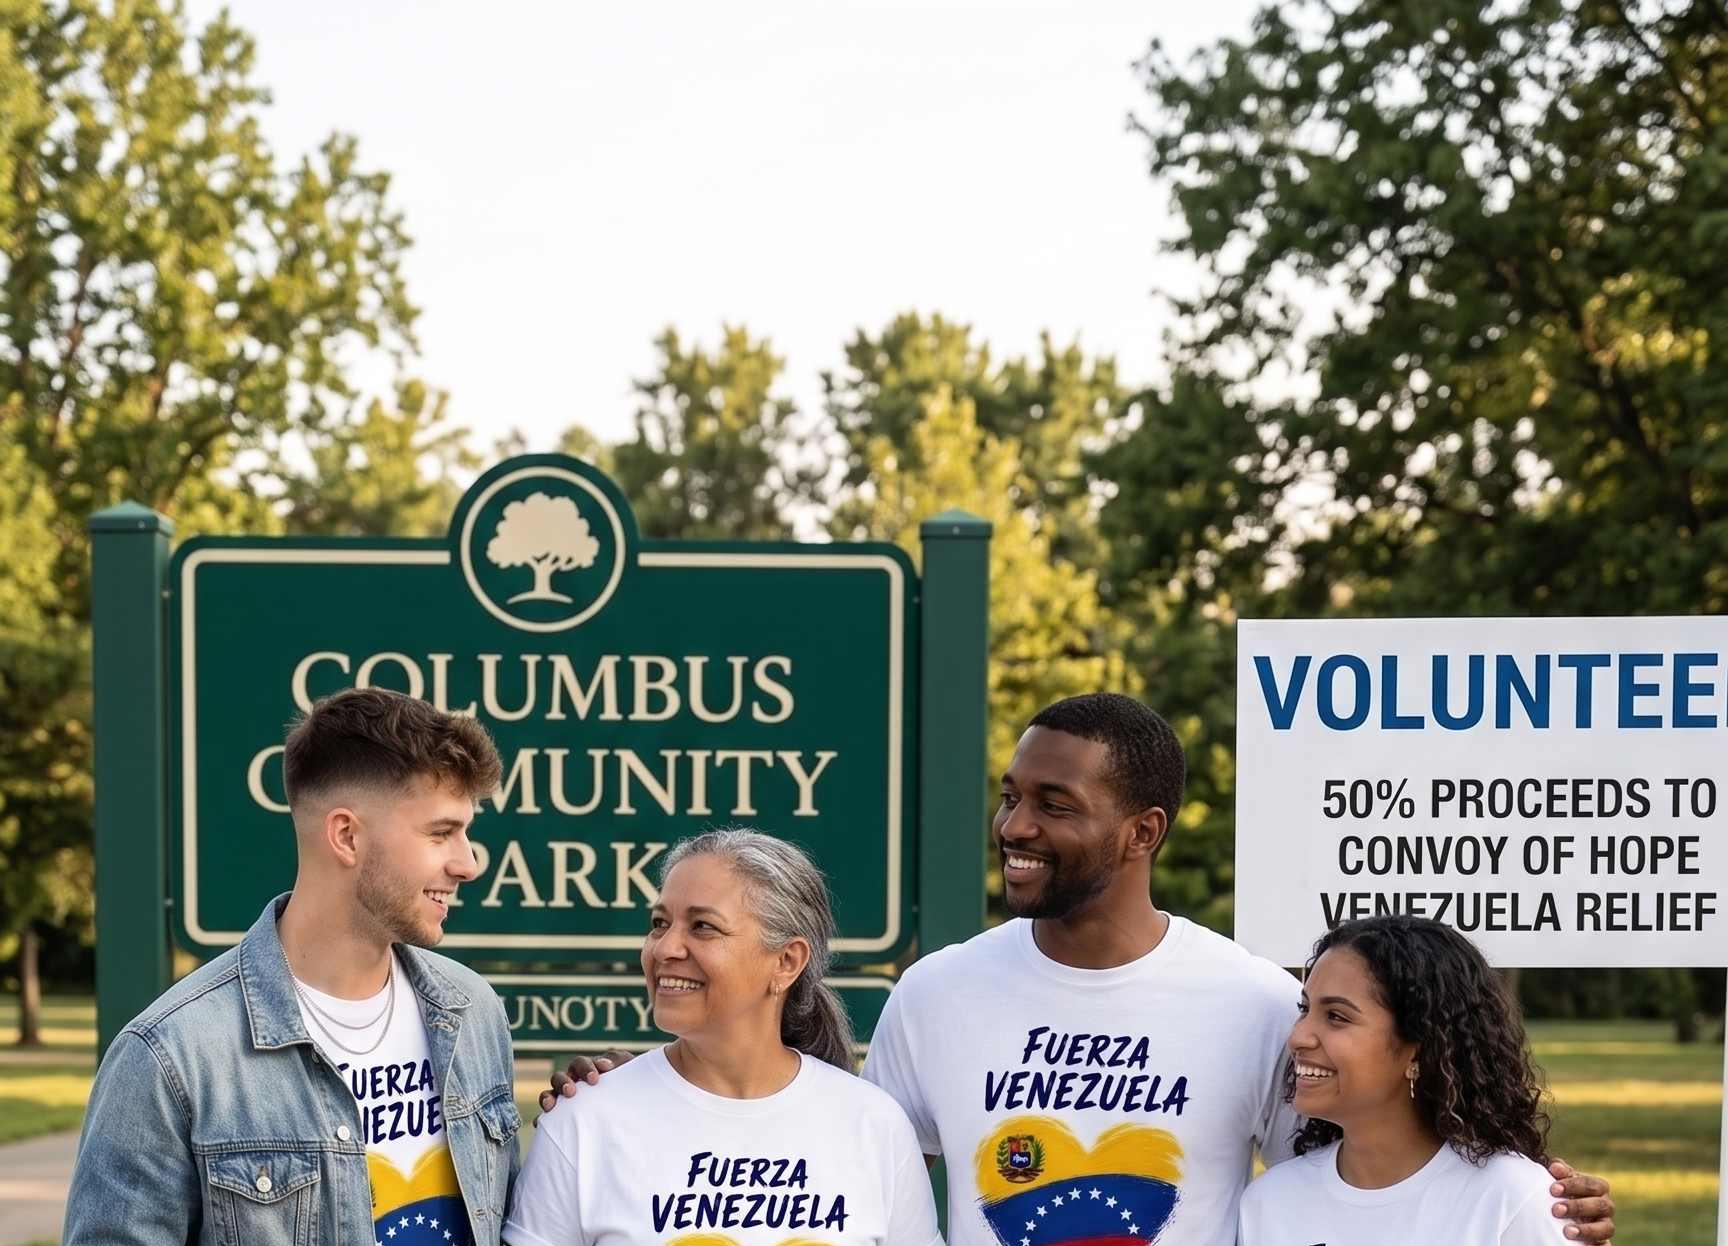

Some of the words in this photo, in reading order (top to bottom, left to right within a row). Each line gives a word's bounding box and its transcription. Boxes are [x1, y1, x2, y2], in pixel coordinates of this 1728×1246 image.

[291, 651, 795, 723] COLUMBUS
[1253, 653, 1728, 731] VOLUNTEE
[1323, 778, 1416, 819] 50%
[1431, 778, 1651, 819] PROCEEDS
[1664, 778, 1717, 818] TO
[1338, 835, 1509, 875] CONVOY
[1522, 835, 1575, 875] OF
[1590, 835, 1701, 875] HOPE
[1577, 892, 1718, 931] RELIEF
[1022, 1026, 1151, 1070] FUERZA
[337, 1059, 434, 1101] UERZA
[984, 1070, 1193, 1116] VENEZUELA
[687, 1151, 808, 1190] FUERZA
[651, 1192, 850, 1233] VENEZUELA
